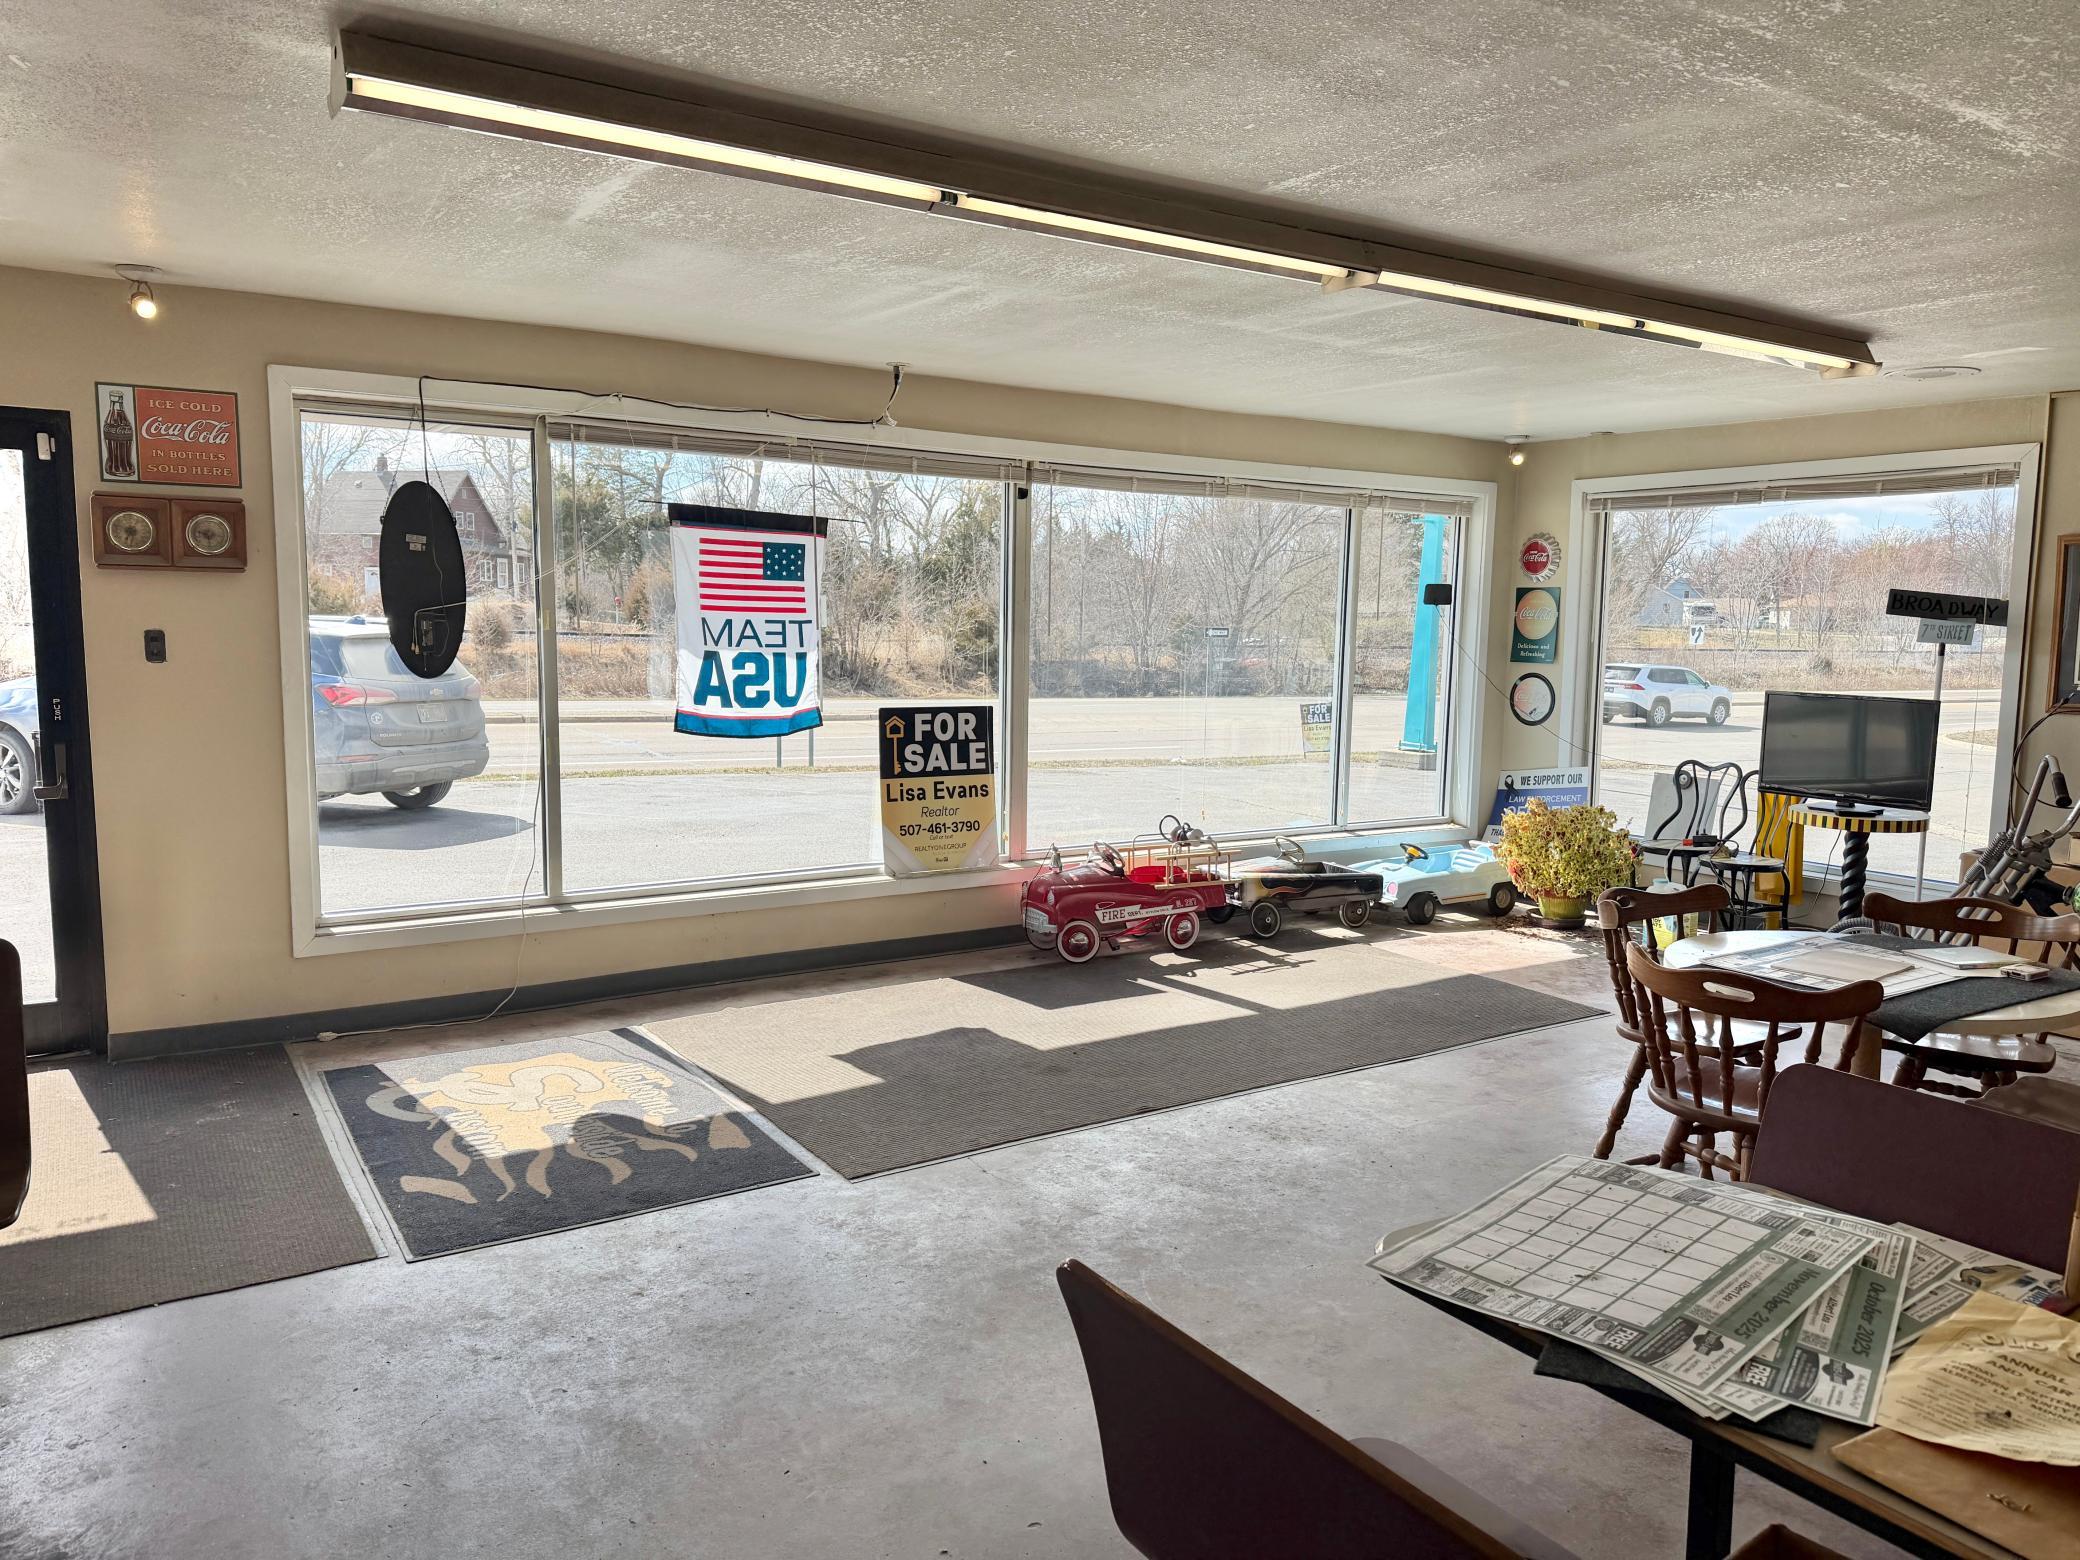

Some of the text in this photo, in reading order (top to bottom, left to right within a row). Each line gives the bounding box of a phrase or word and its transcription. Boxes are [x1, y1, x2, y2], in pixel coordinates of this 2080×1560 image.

[149, 399, 221, 413] ICE COLD
[141, 415, 231, 445] Coca-Cola
[152, 449, 226, 461] IN BOTTLES
[146, 464, 232, 477] SOLD HERE
[1891, 592, 1999, 618] BROADWAY
[1936, 624, 1971, 641] STREET
[53, 698, 62, 721] PUSH
[1308, 713, 1331, 723] SALE
[1310, 705, 1327, 714] FOR
[914, 712, 977, 741] FOR
[904, 742, 986, 773] SALE
[1520, 773, 1583, 786] WE SUPPORT OUR
[886, 780, 989, 802] Lisa Evans
[1508, 795, 1526, 803] LAW
[921, 805, 960, 818] Realtor
[900, 820, 980, 837] 507-461-3790
[1102, 909, 1126, 920] FIRE
[1763, 1268, 1820, 1315] November
[1734, 1311, 1770, 1340] 2025
[1852, 1282, 1886, 1357] October 2025
[1606, 1325, 1640, 1350] FREE
[1746, 1362, 1771, 1387] FREE
[1939, 1366, 1986, 1387] ALBERT
[1985, 1360, 2073, 1396] AND CAR
[1996, 1354, 2068, 1385] ANNUAL
